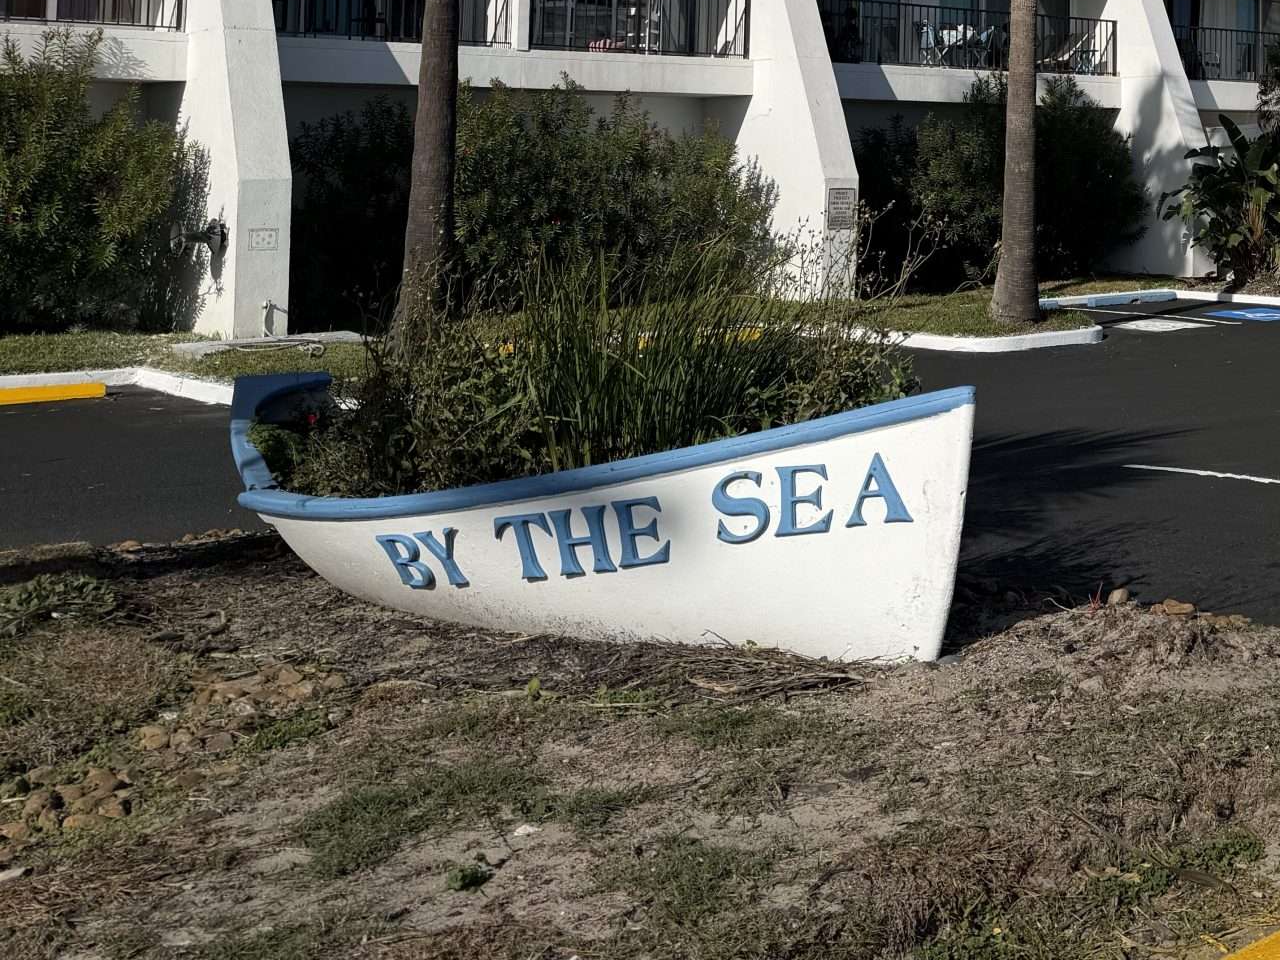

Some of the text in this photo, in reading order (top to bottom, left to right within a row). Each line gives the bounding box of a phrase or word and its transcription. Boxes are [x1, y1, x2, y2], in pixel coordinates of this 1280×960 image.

[375, 452, 914, 589] BY THE SEA
